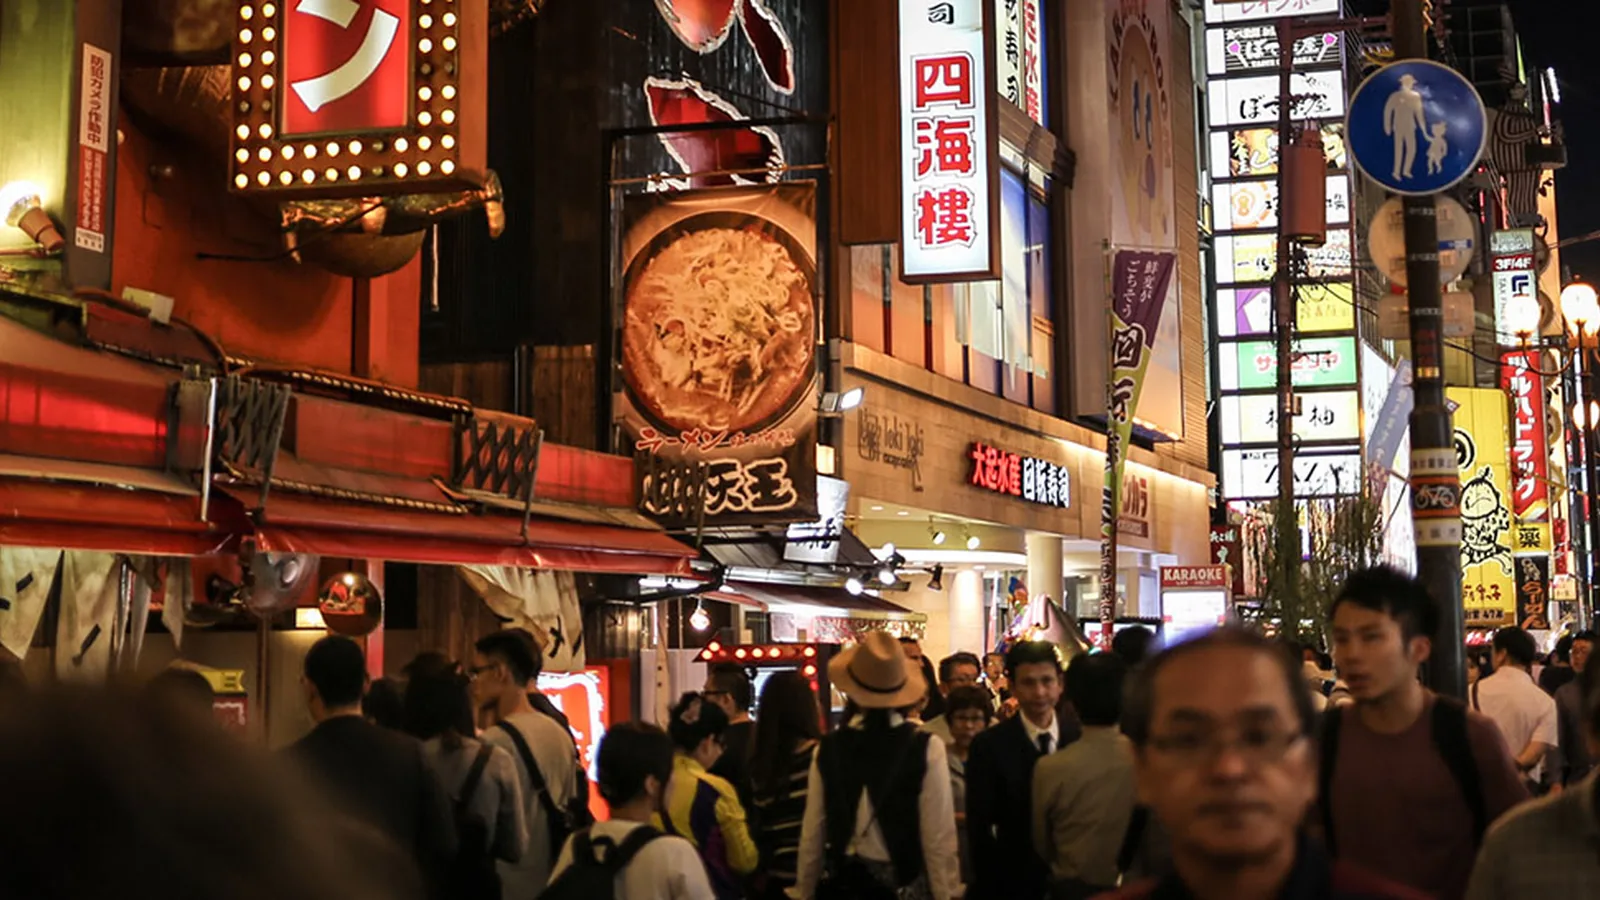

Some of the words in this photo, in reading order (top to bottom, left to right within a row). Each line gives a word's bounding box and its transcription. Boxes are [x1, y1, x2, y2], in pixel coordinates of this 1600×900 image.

[927, 2, 954, 25] 司
[1122, 259, 1140, 318] ごちそう
[636, 427, 728, 453] ラーメン
[1163, 568, 1222, 581] KARAOKE
